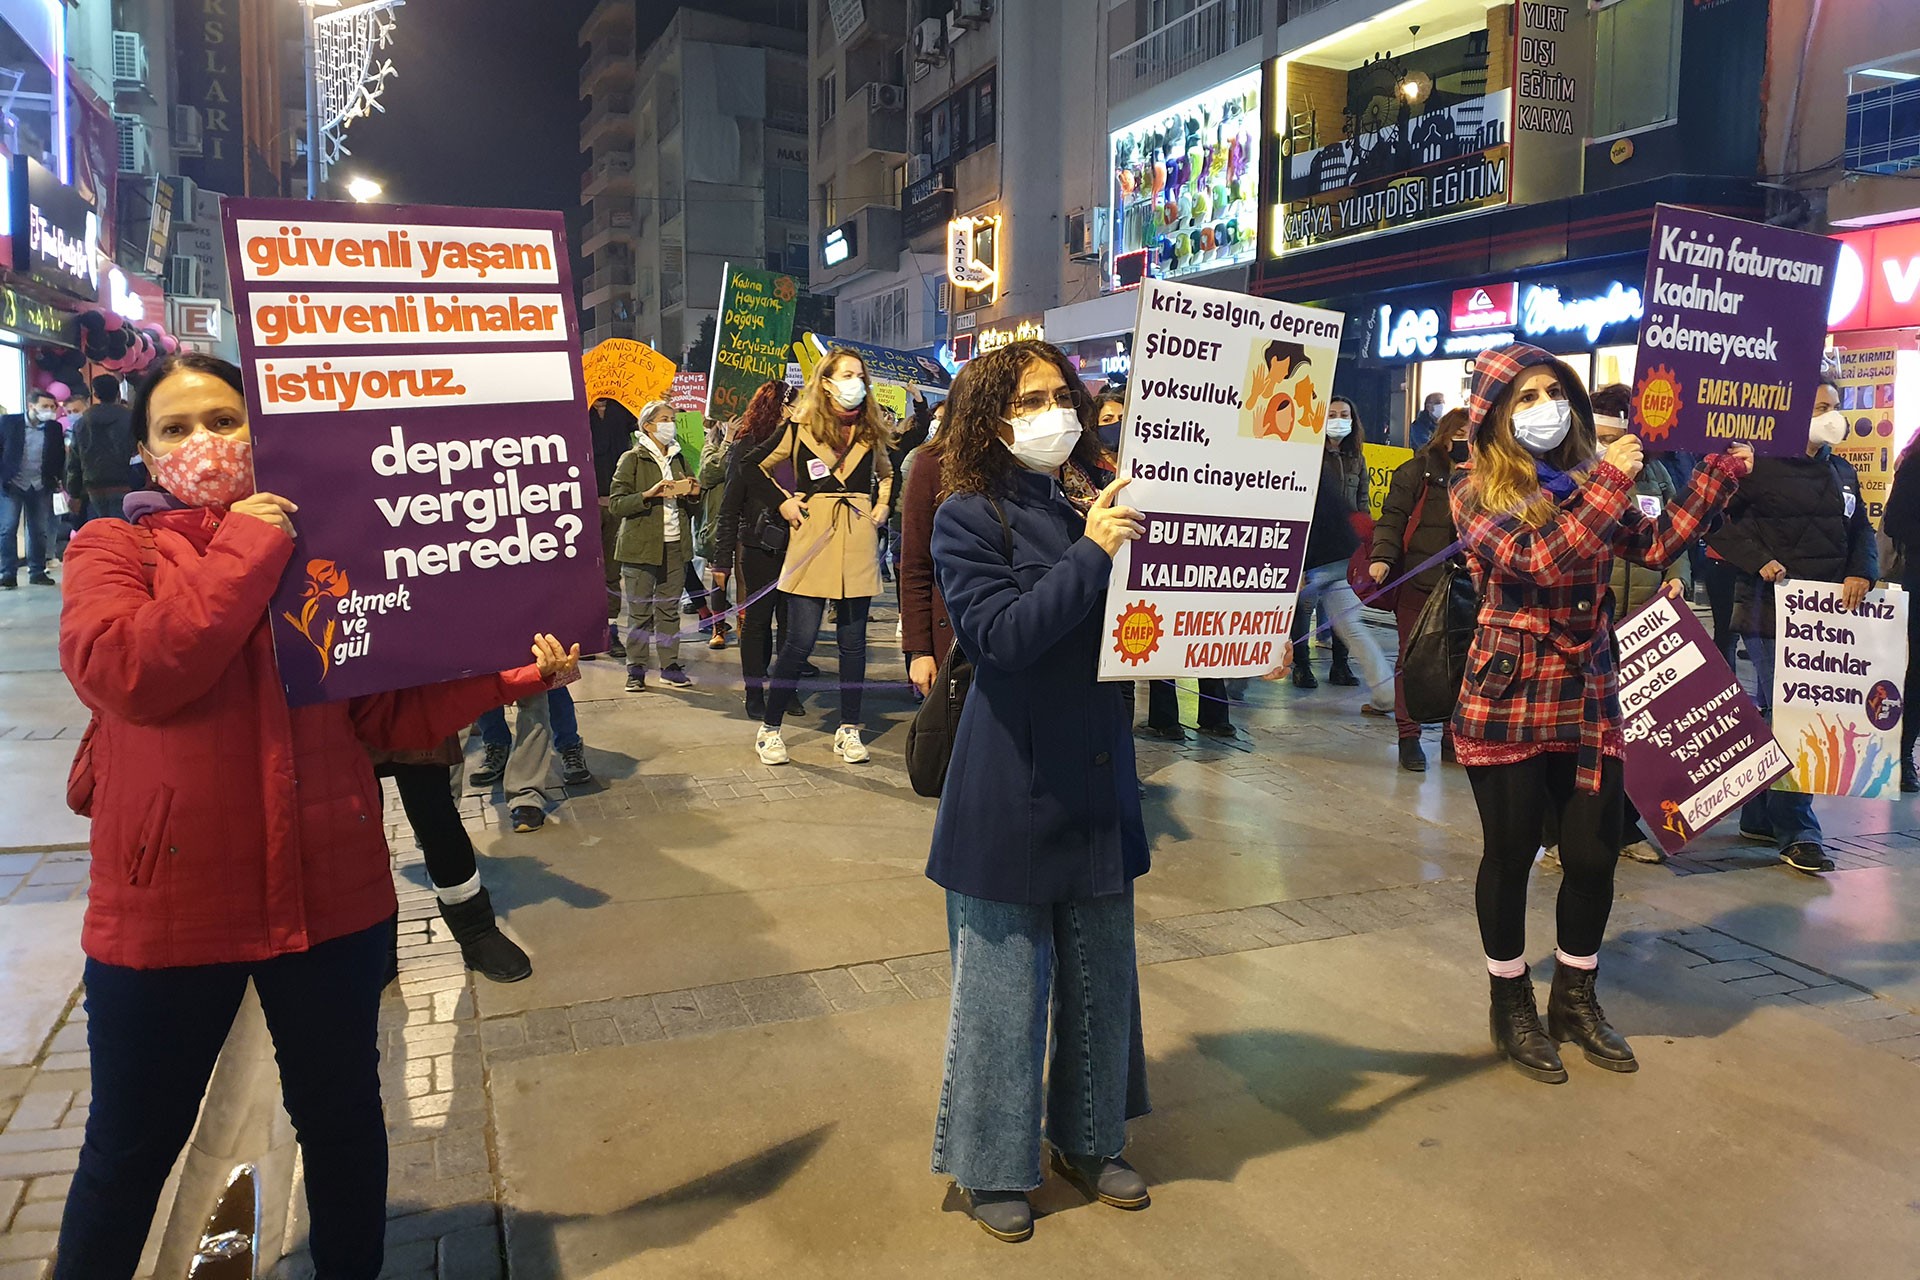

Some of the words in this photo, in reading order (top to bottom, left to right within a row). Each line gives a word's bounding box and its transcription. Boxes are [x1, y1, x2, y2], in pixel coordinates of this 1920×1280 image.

[1523, 2, 1568, 32] YURT
[1520, 37, 1555, 66] DIŞI
[1519, 72, 1576, 103] EĞİTİM
[1519, 104, 1573, 135] KARYA
[1281, 203, 1332, 243] KARYA
[1432, 158, 1504, 208] EĞİTİM
[247, 226, 412, 276] güvenli
[417, 230, 552, 278] yaşam
[955, 229, 966, 281] TATTOO
[1658, 225, 1723, 270] Krizin
[1726, 236, 1824, 286] faturasını
[1653, 268, 1744, 315] kadınlar
[256, 294, 420, 345] güvenli
[423, 295, 558, 333] binalar
[1151, 289, 1197, 320] kriz,
[1202, 301, 1265, 331] salgın,
[1270, 310, 1339, 339] deprem
[1146, 329, 1222, 362] ŞİDDET
[1379, 304, 1440, 358] Lee
[1645, 314, 1779, 365] ödemeyecek
[1858, 350, 1895, 363] KIRMIZI
[264, 361, 467, 411] istiyoruz.
[1141, 378, 1243, 409] yoksulluk,
[1644, 393, 1674, 412] EMEP
[1697, 377, 1739, 407] EMEK
[1740, 380, 1793, 412] PARTİLİ
[1134, 415, 1210, 447] işsizlik,
[1705, 411, 1776, 441] KADINLAR
[371, 425, 568, 485] deprem
[1131, 458, 1188, 483] kadın
[1193, 463, 1307, 492] cinayetleri...
[374, 465, 583, 533] vergileri
[383, 514, 583, 580] nerede?
[1149, 520, 1179, 545] BU
[1182, 523, 1258, 549] ENKAZI
[1260, 522, 1292, 550] BİZ
[1140, 563, 1290, 590] KALDIRACAĞIZ
[337, 584, 411, 617] ekmek
[1785, 589, 1895, 620] şiddeiniz
[341, 617, 368, 636] ve
[1124, 625, 1154, 641] EMEP
[1173, 610, 1227, 637] EMEK
[1229, 605, 1293, 635] PARTİLİ
[1620, 609, 1670, 654] melik
[1785, 616, 1855, 645] batsın
[333, 633, 371, 665] gül
[1184, 641, 1272, 669] KADINLAR
[1784, 646, 1872, 676] kadınlar
[1621, 667, 1677, 711] reçete
[1783, 682, 1863, 706] yaşasın
[1673, 682, 1741, 733] istiyoruz
[1623, 709, 1658, 745] eğil
[1687, 734, 1754, 784] istiyoruz
[1688, 776, 1740, 823] ekmek
[1735, 768, 1754, 788] ve
[1757, 745, 1780, 781] gül
